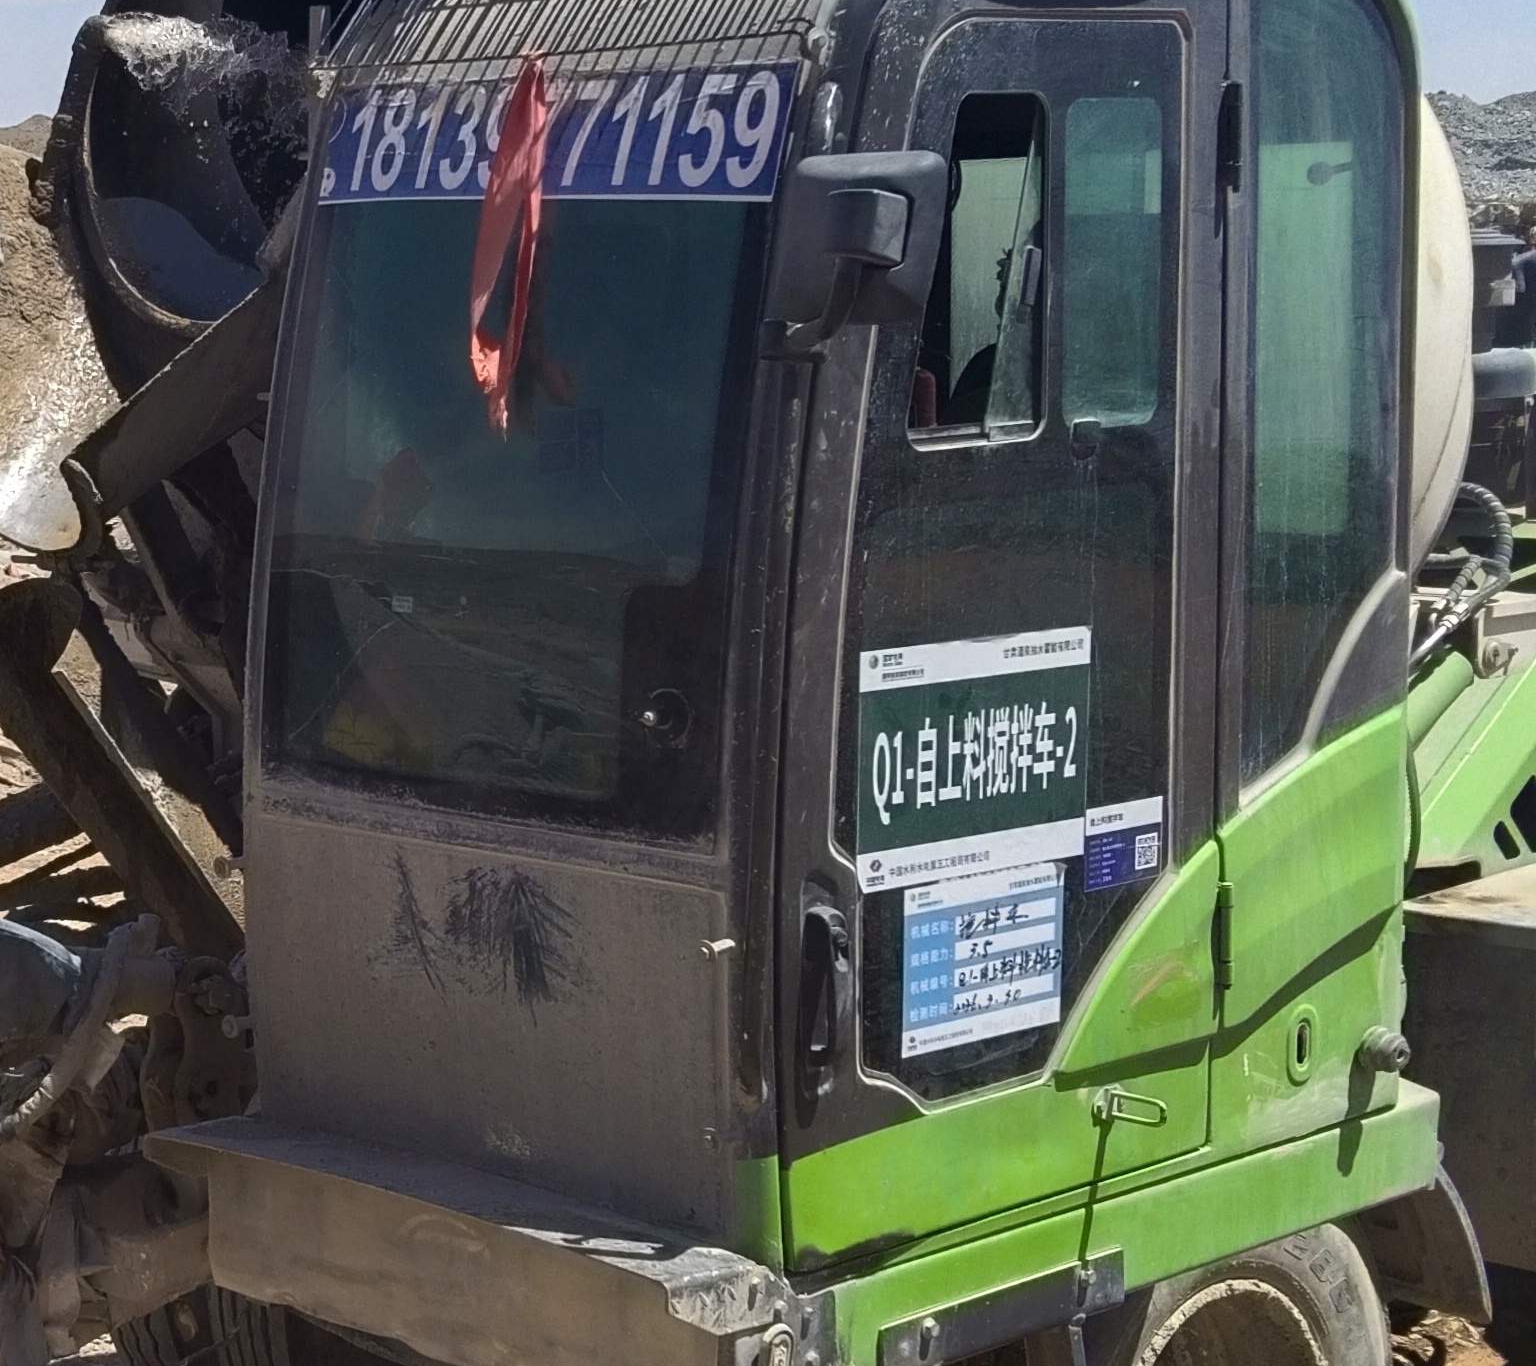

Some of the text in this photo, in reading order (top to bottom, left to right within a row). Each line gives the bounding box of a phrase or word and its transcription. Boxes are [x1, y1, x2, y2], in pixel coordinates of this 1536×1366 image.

[872, 701, 1077, 825] Q1-自上料搅拌车-2
